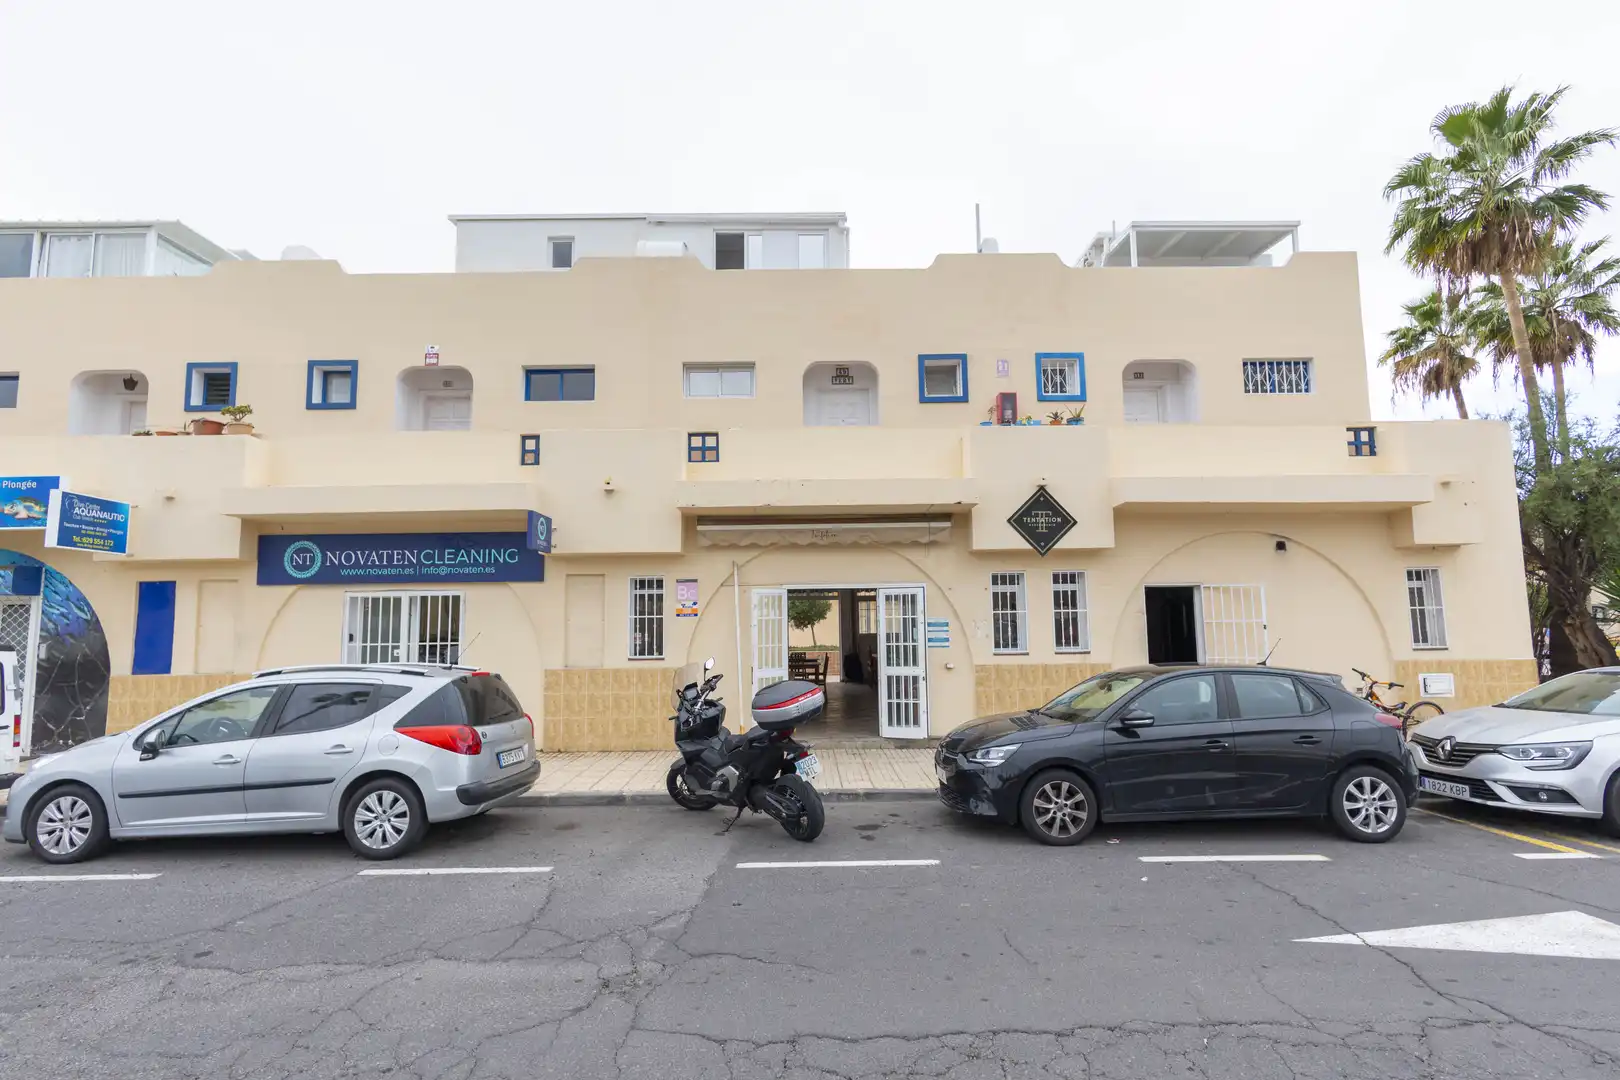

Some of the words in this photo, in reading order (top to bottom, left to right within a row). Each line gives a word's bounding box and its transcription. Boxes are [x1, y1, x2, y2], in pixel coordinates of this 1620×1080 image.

[2, 480, 37, 490] Plongée
[73, 507, 125, 522] AQUANAUTIC
[292, 553, 314, 566] NT
[325, 550, 418, 566] NOVATEN
[420, 548, 519, 564] CLEANING
[340, 566, 414, 576] www.novaten.es
[421, 565, 496, 576] info@novaten.es
[800, 755, 817, 770] 2023
[1427, 780, 1447, 793] 1822
[1449, 784, 1467, 797] KBP
